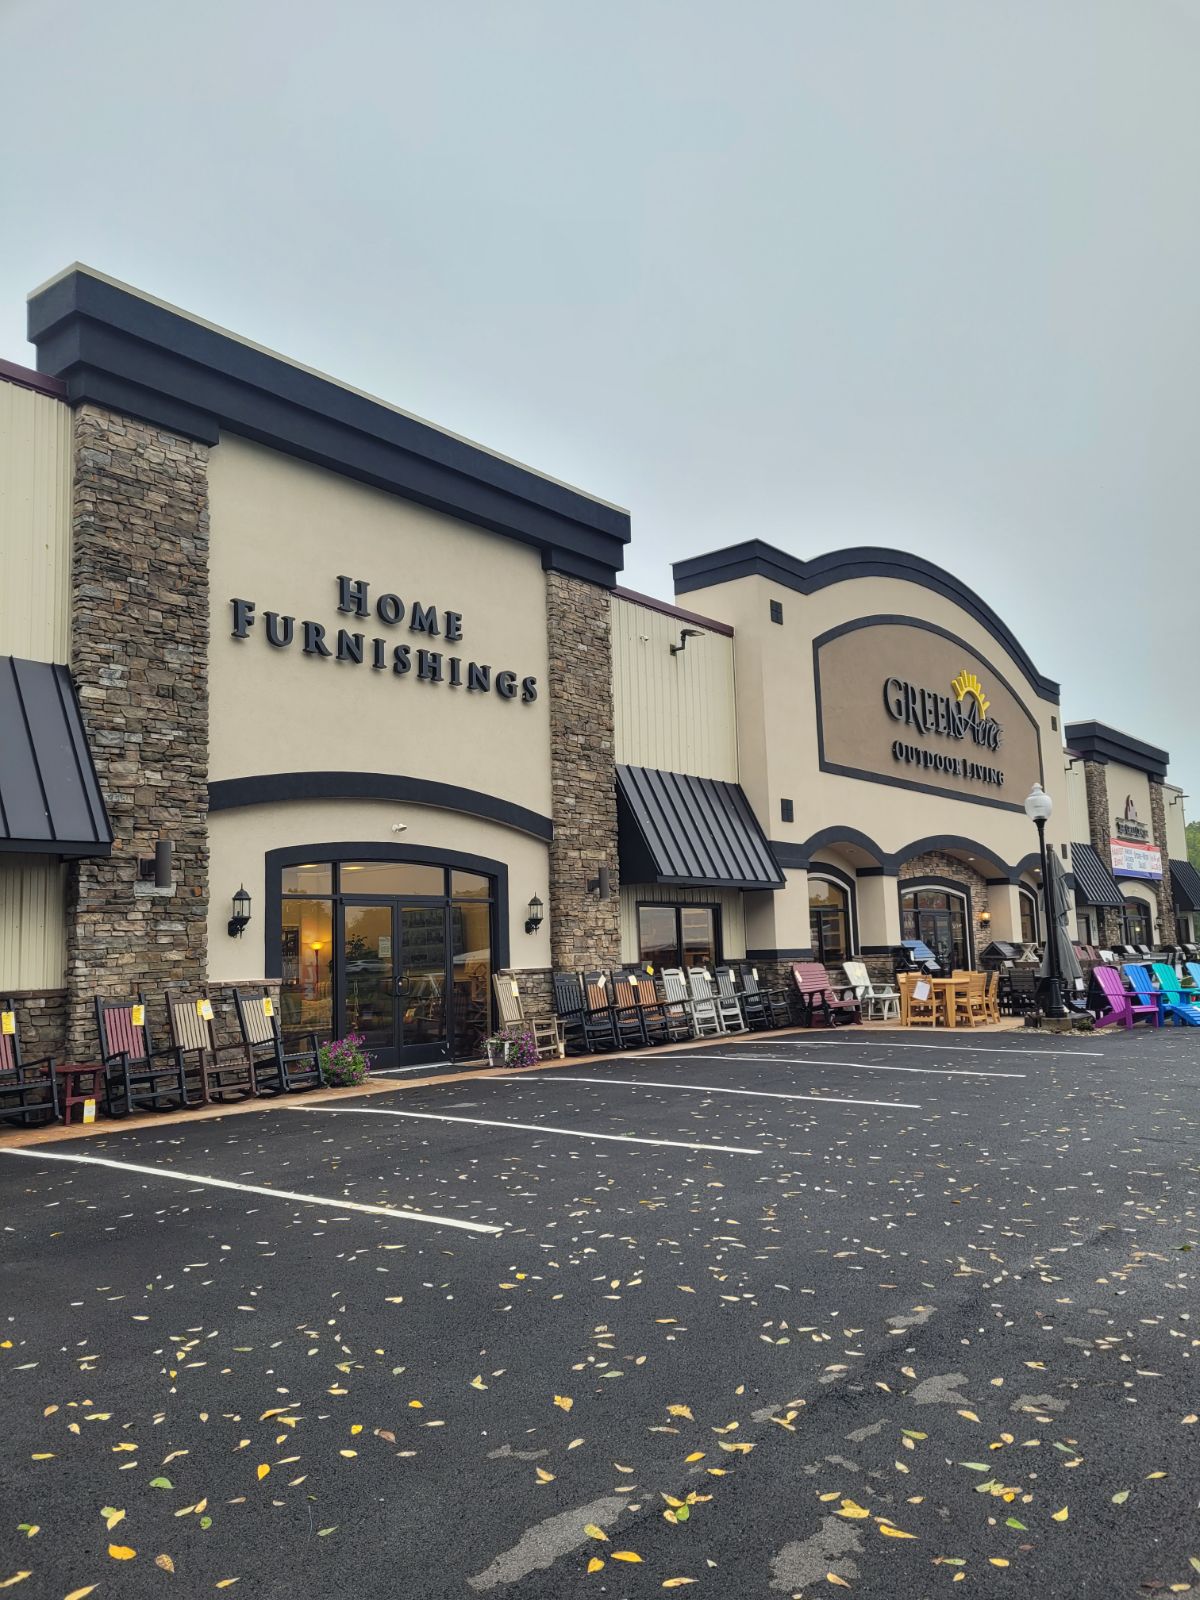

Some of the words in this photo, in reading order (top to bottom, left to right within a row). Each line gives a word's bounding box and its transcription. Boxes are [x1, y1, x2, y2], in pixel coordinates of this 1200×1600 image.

[336, 574, 463, 641] HOME
[230, 597, 538, 702] FURNISHINGS
[883, 676, 963, 739] GREEN
[892, 740, 961, 776] OUTDOOR
[962, 758, 1004, 786] LIVING
